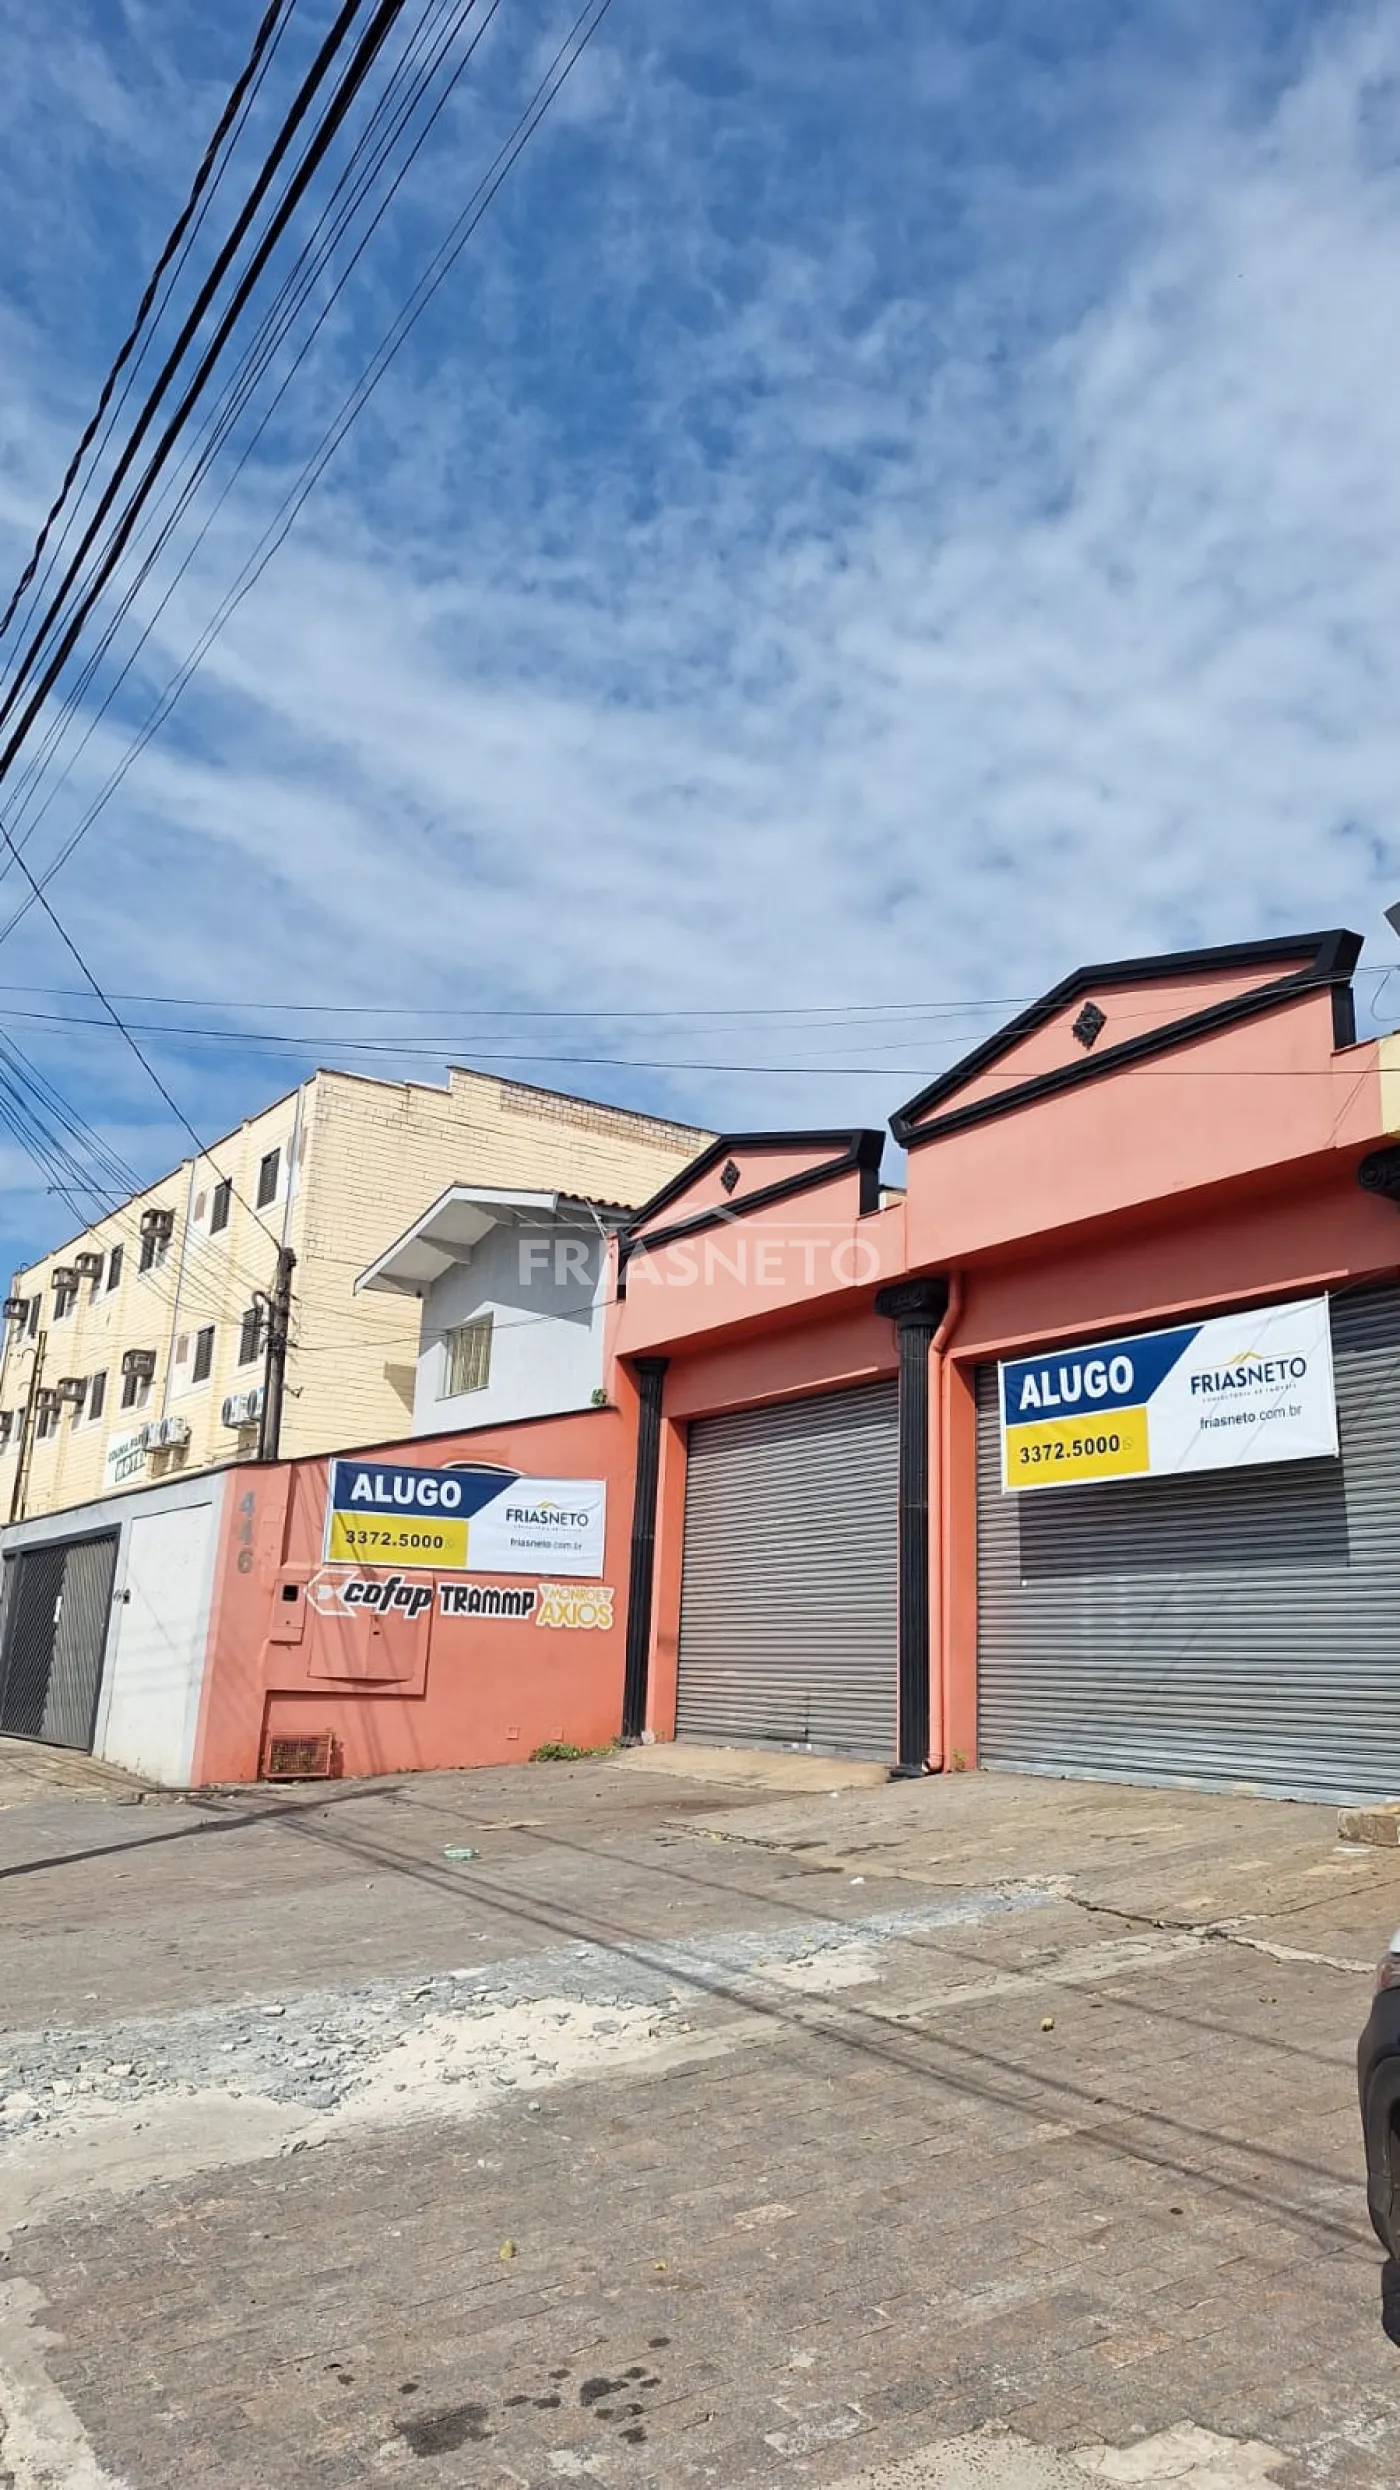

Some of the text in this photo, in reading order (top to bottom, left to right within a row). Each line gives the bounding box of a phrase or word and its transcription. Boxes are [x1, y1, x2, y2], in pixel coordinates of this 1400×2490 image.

[1019, 1355, 1135, 1411] ALUGO
[1190, 1357, 1307, 1395] FRIASNETO
[1200, 1403, 1303, 1430] friasneto.com.br
[1019, 1434, 1120, 1464] 3372.5000
[350, 1472, 462, 1508] ALUGO
[505, 1508, 589, 1527] FRIASNETO
[345, 1529, 444, 1550] 3372.5000
[343, 1575, 433, 1617] cofap
[538, 1601, 611, 1626] AXIOS
